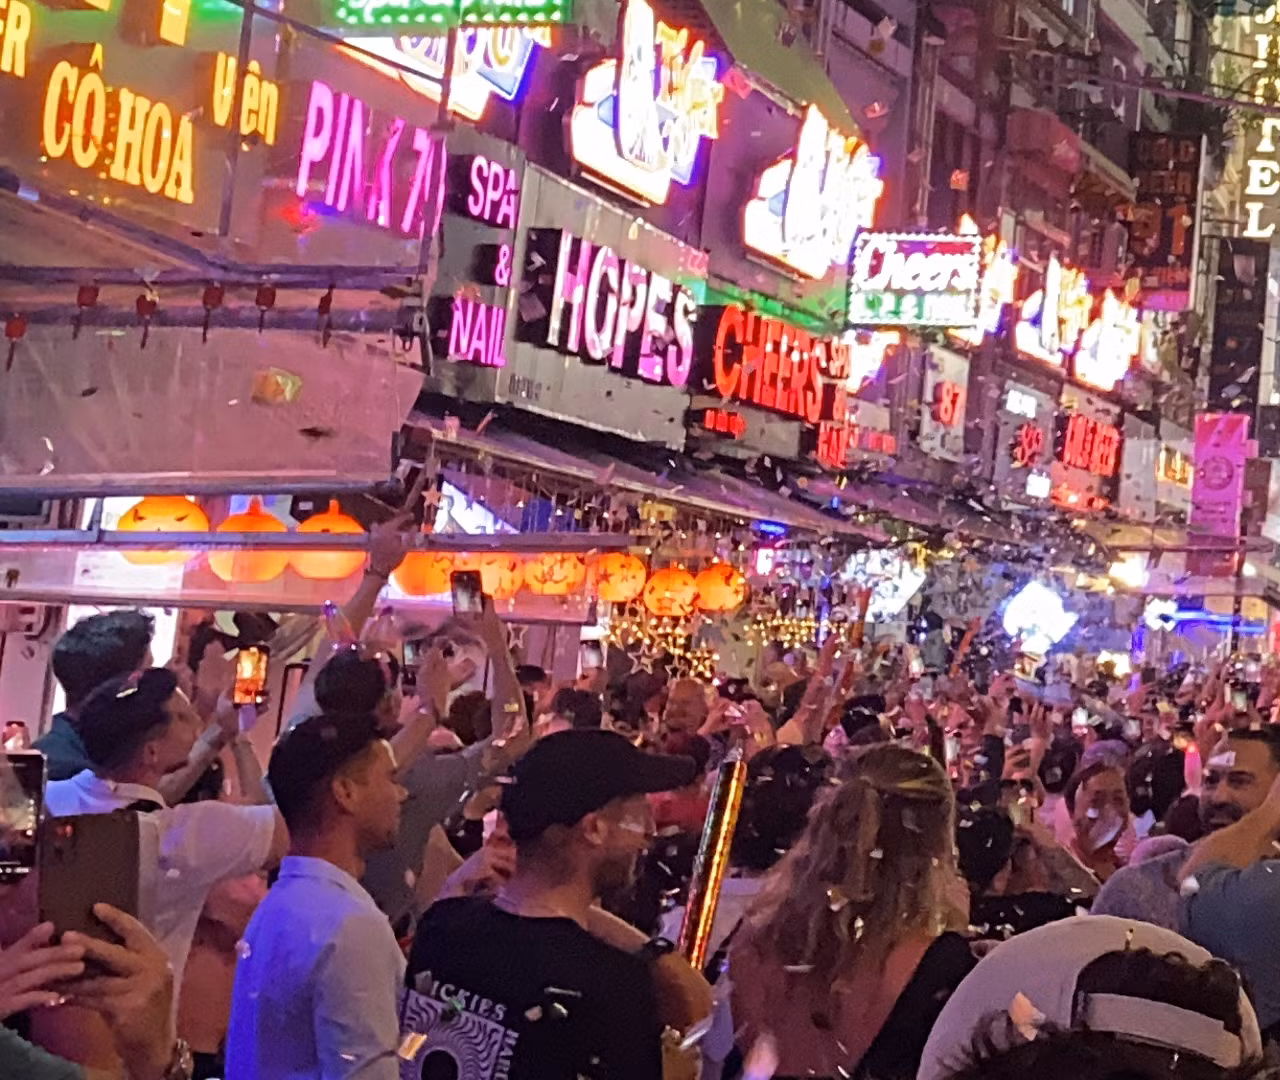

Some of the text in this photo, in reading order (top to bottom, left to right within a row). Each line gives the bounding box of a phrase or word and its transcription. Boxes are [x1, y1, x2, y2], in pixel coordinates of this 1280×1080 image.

[43, 42, 195, 204] CÔ HOA
[468, 155, 517, 229] SPA
[495, 244, 511, 287] &
[449, 296, 507, 369] NAIL
[547, 229, 698, 387] HOPES
[714, 304, 823, 423] CHEERS
[429, 979, 508, 1021] ICKIES
